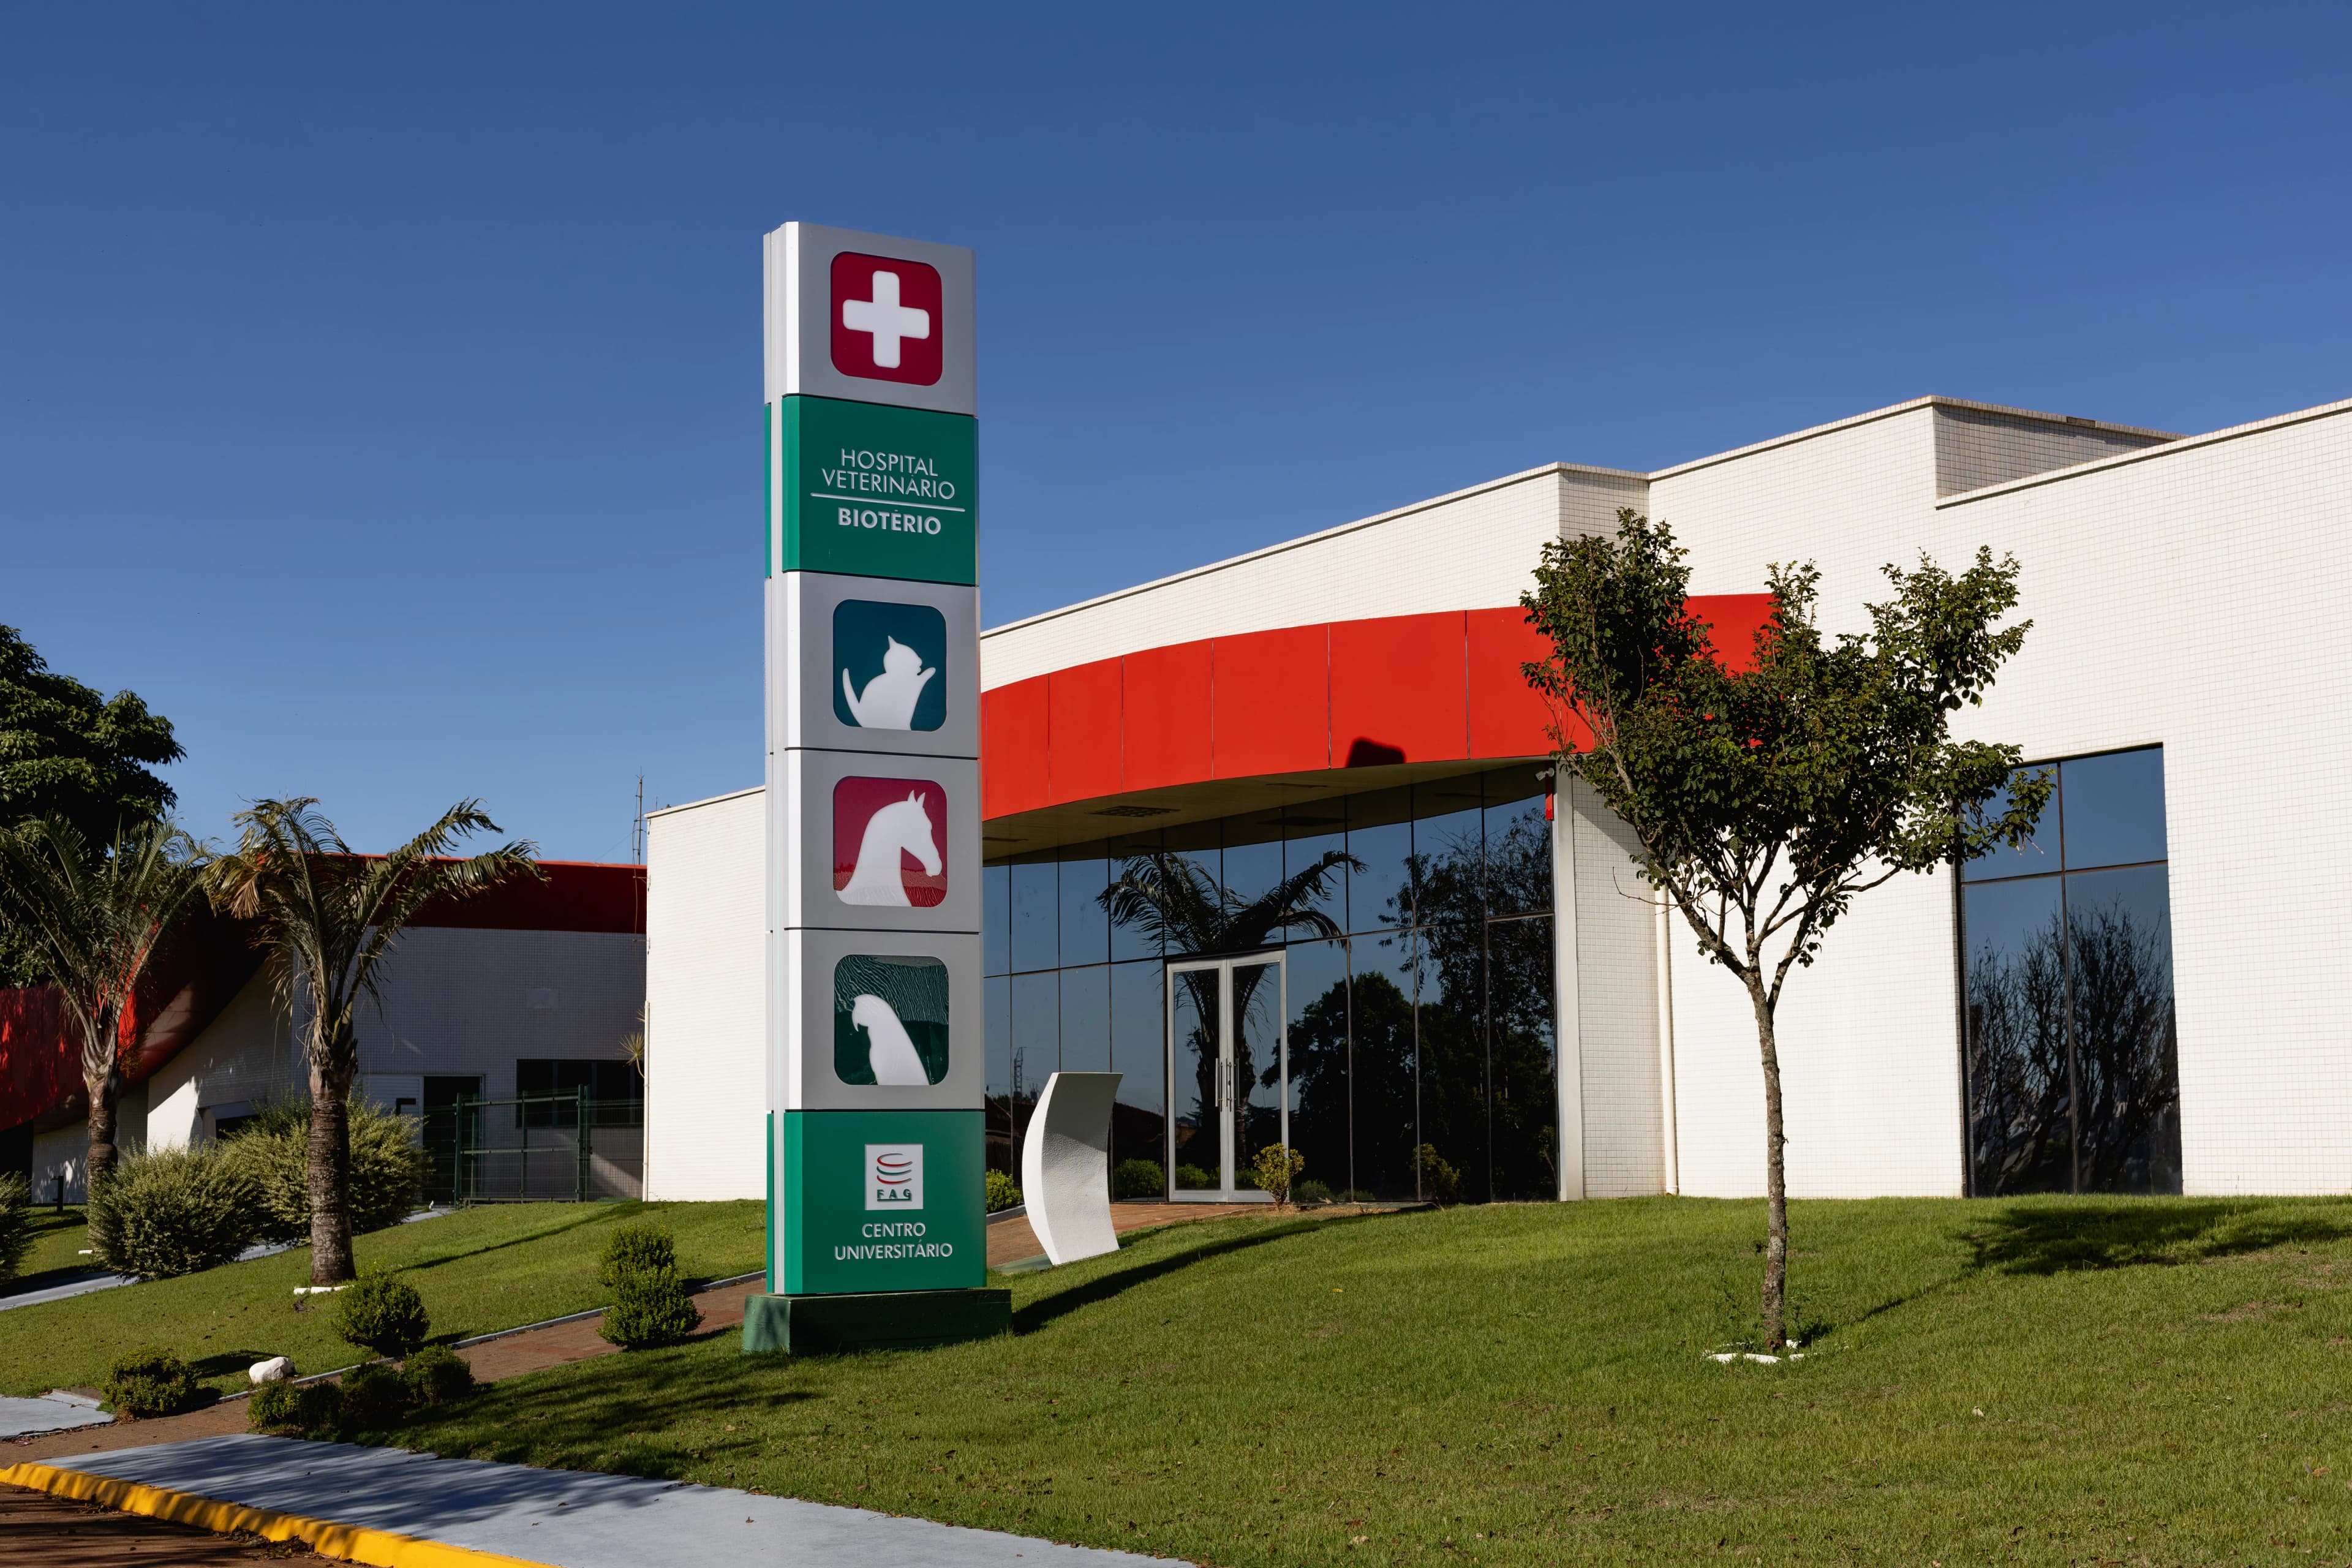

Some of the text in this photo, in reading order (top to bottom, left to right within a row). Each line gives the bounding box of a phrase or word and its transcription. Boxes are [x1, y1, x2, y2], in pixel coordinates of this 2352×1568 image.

[841, 448, 938, 477] HOSPITAL
[862, 1222, 926, 1238] CENTRO
[834, 1239, 953, 1261] UNIVERSITÁRIO
